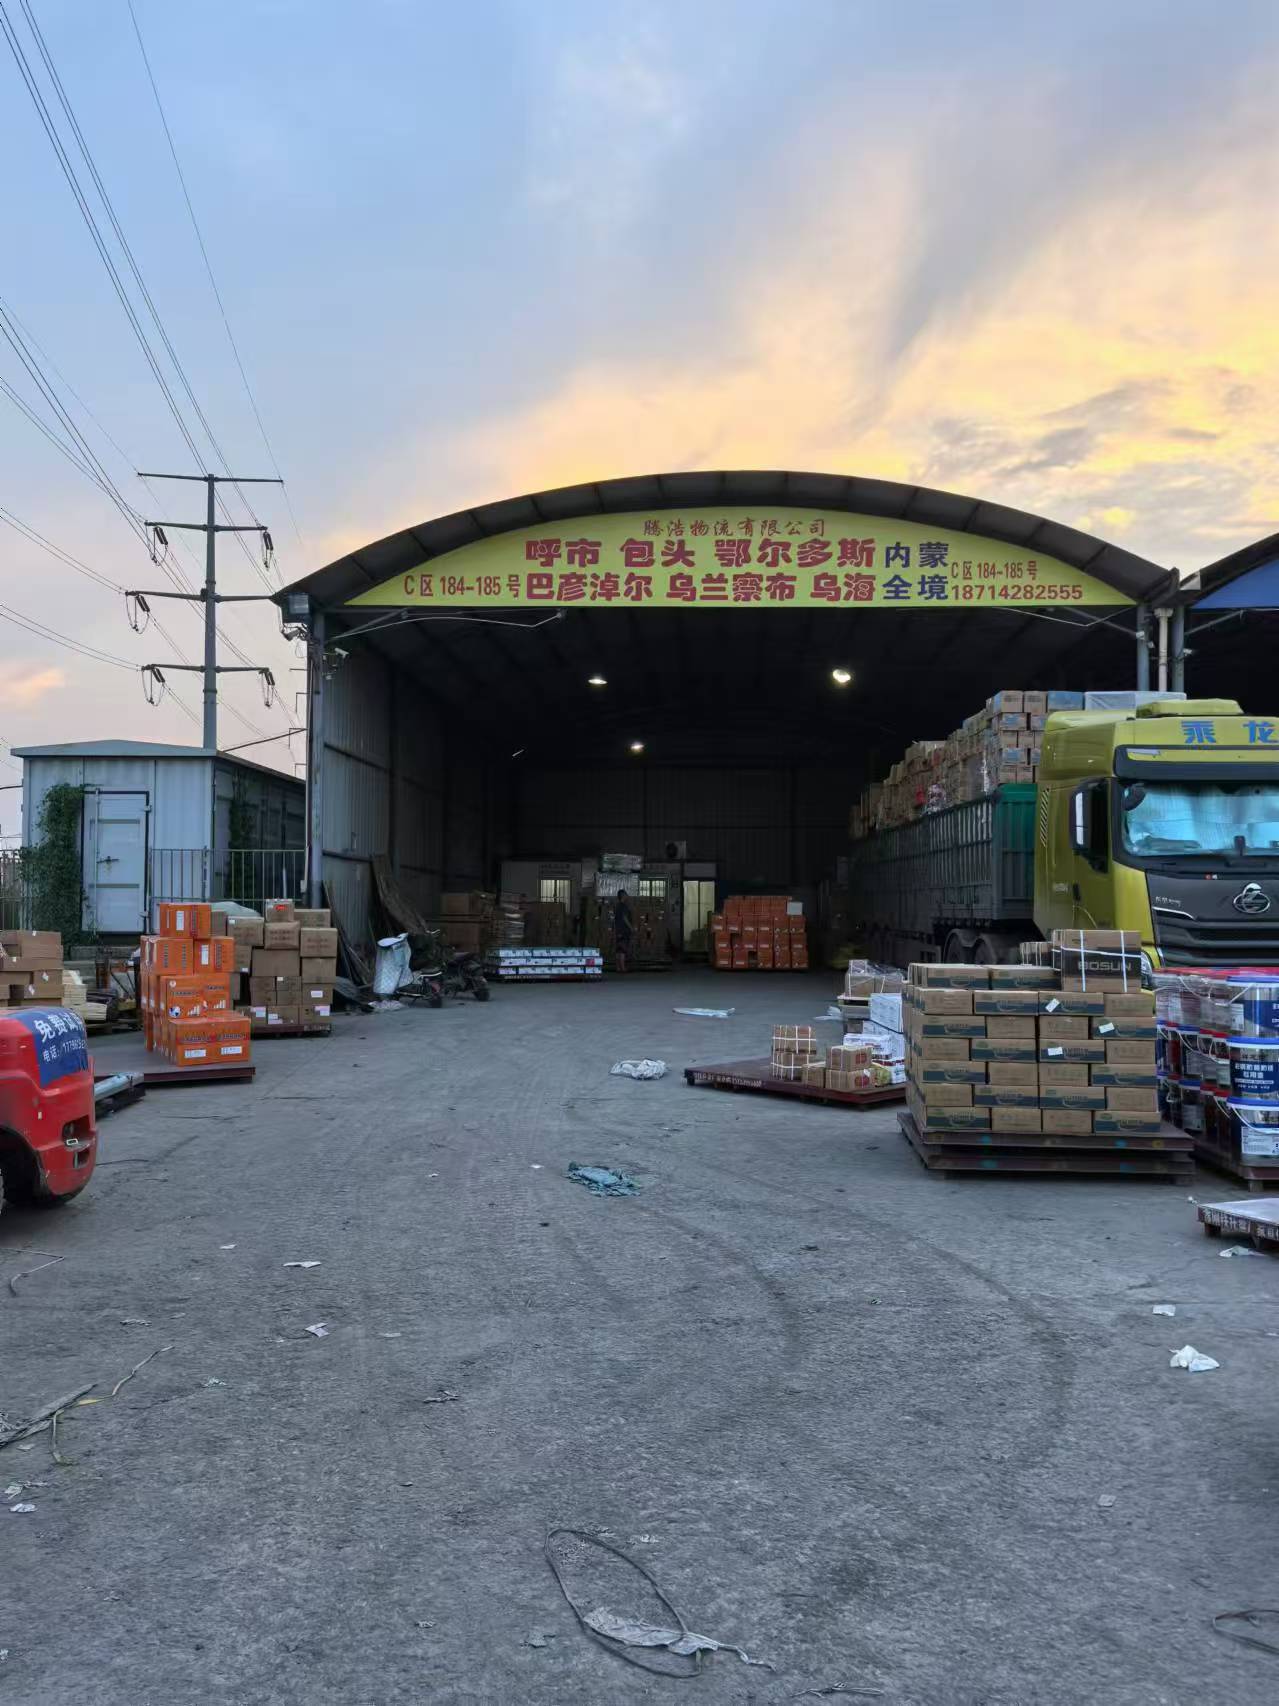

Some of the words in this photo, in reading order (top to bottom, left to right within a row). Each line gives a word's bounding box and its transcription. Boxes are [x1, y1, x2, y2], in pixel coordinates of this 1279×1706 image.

[526, 538, 602, 568] 呼市
[620, 538, 696, 567] 包头
[714, 538, 877, 568] 鄂尔多斯
[884, 541, 949, 568] 内蒙
[526, 572, 653, 602] 巴彦淖尔
[666, 572, 797, 602] 乌兰察布
[810, 572, 877, 602] 乌海
[881, 574, 949, 601] 全境
[951, 585, 1083, 600] 18714282555
